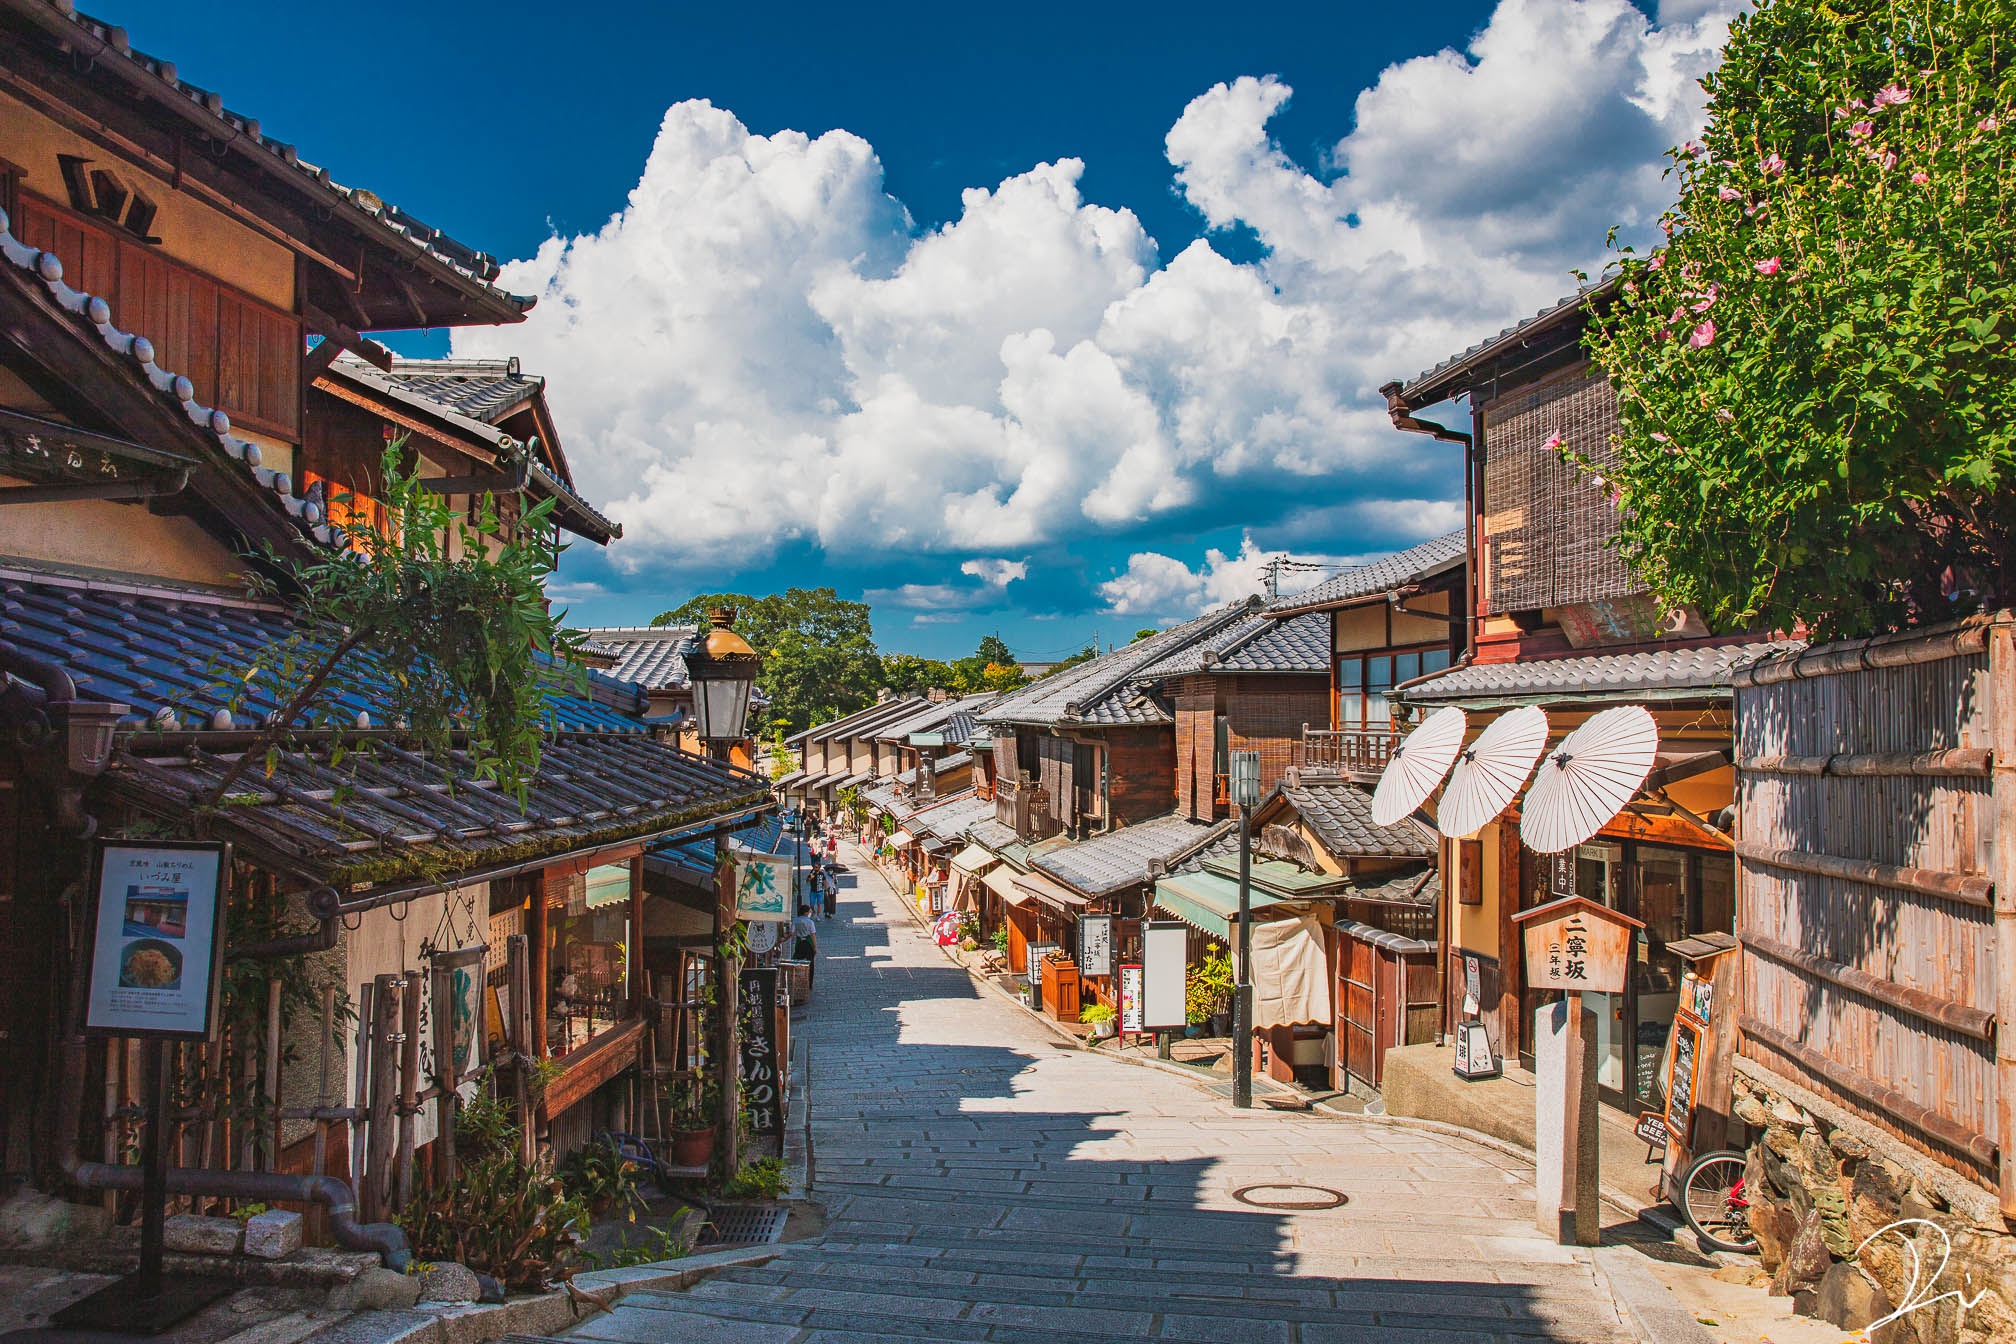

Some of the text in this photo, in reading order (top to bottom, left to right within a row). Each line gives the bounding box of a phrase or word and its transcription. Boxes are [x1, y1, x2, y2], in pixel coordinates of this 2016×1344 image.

[139, 871, 183, 884] いづみ屋
[743, 862, 777, 895] 氷
[1558, 850, 1567, 890] 業中
[1084, 946, 1094, 970] ふたば
[1564, 918, 1588, 980] 二寧坂
